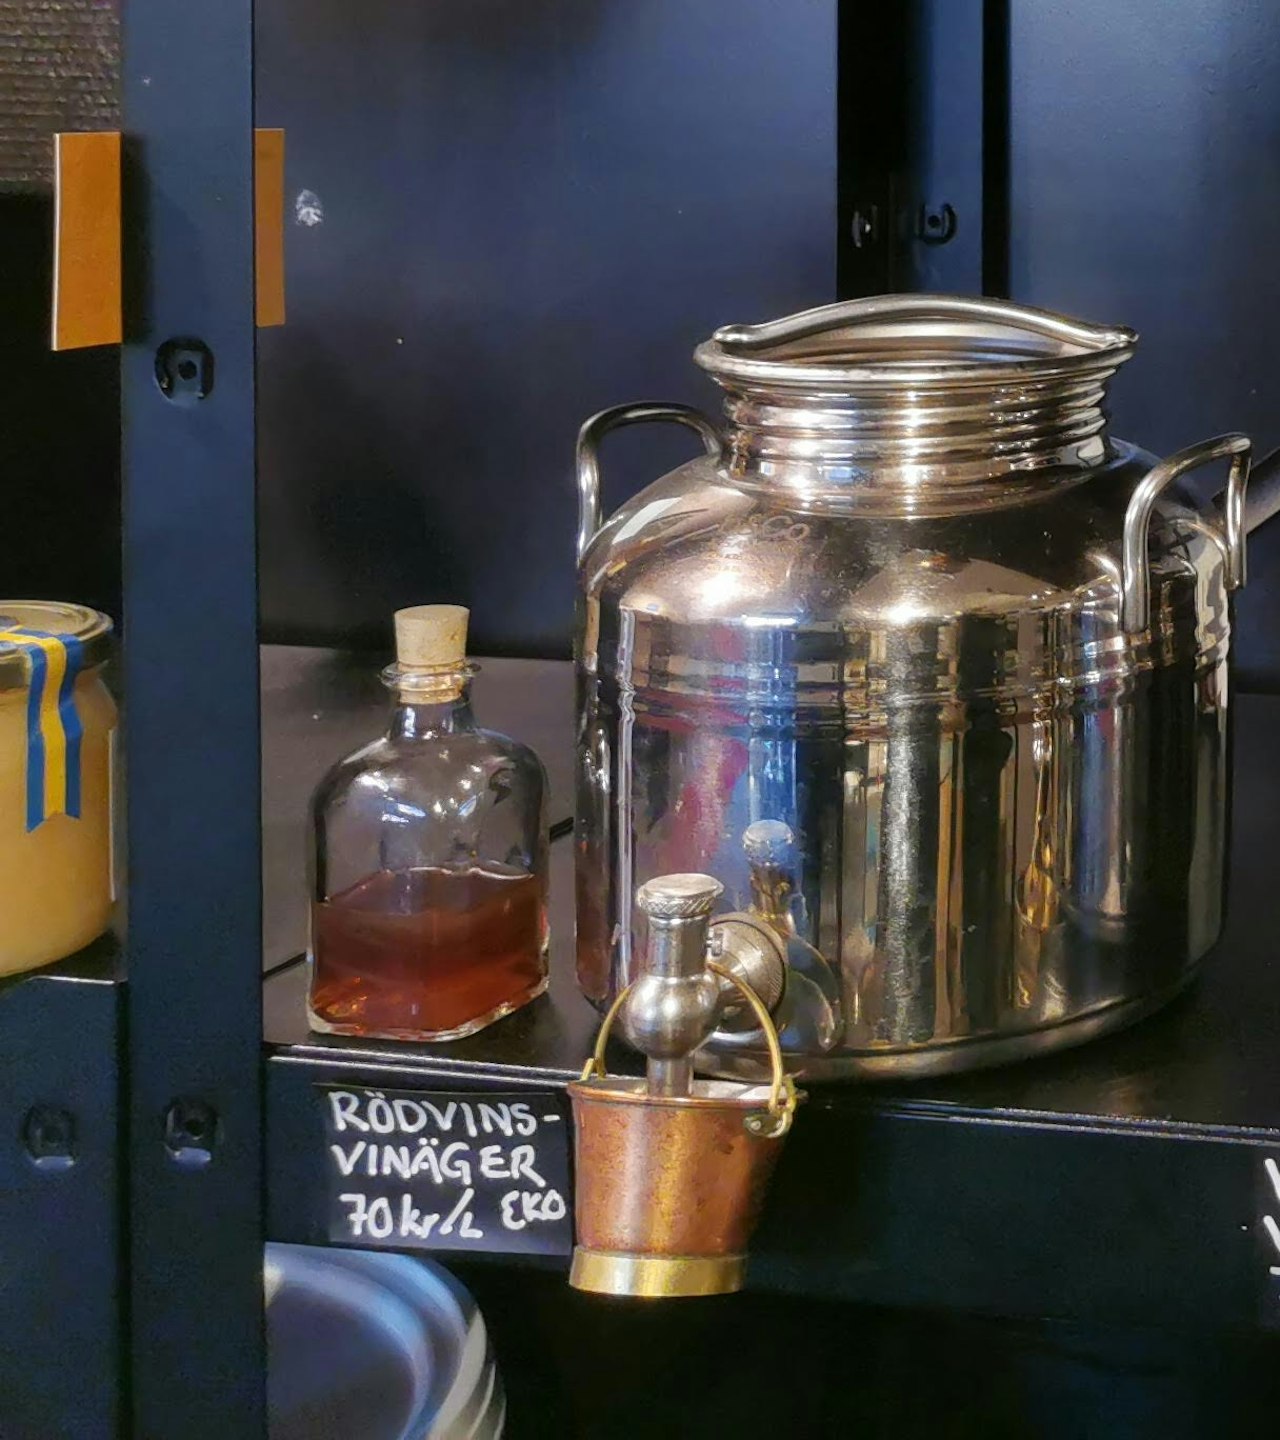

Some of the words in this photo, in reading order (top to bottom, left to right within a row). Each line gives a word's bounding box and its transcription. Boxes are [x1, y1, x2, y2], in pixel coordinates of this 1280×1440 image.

[328, 1091, 561, 1137] RÖDVINS-
[331, 1137, 546, 1187] VINÄGER
[340, 1187, 483, 1239] 70kr/L
[501, 1189, 566, 1230] EKO
